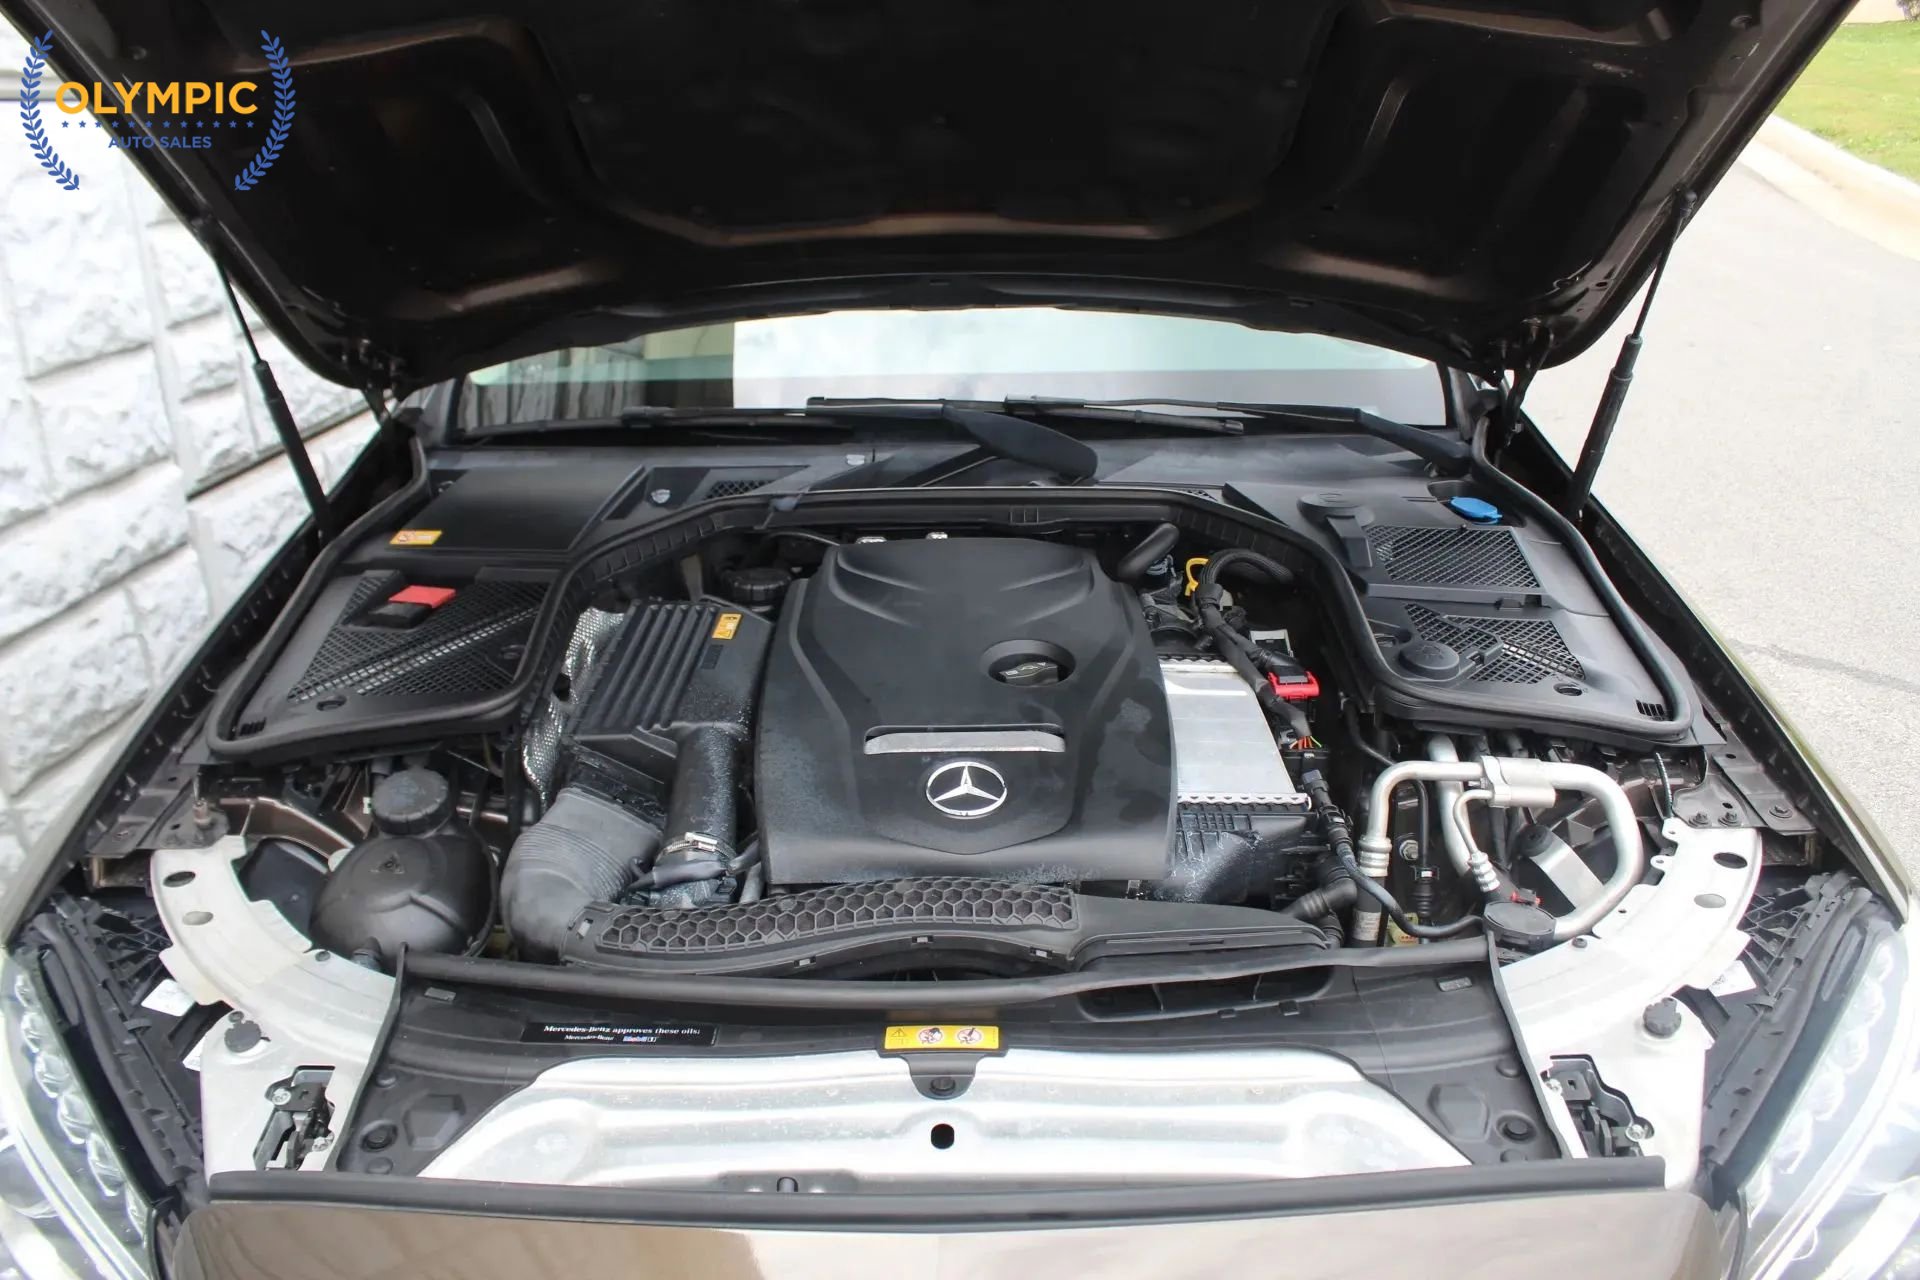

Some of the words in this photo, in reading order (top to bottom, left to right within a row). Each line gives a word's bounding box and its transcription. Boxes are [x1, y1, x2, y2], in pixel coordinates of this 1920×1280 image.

[543, 1025, 611, 1034] Mercedes-Benz
[612, 1027, 653, 1035] approves
[655, 1027, 680, 1035] these
